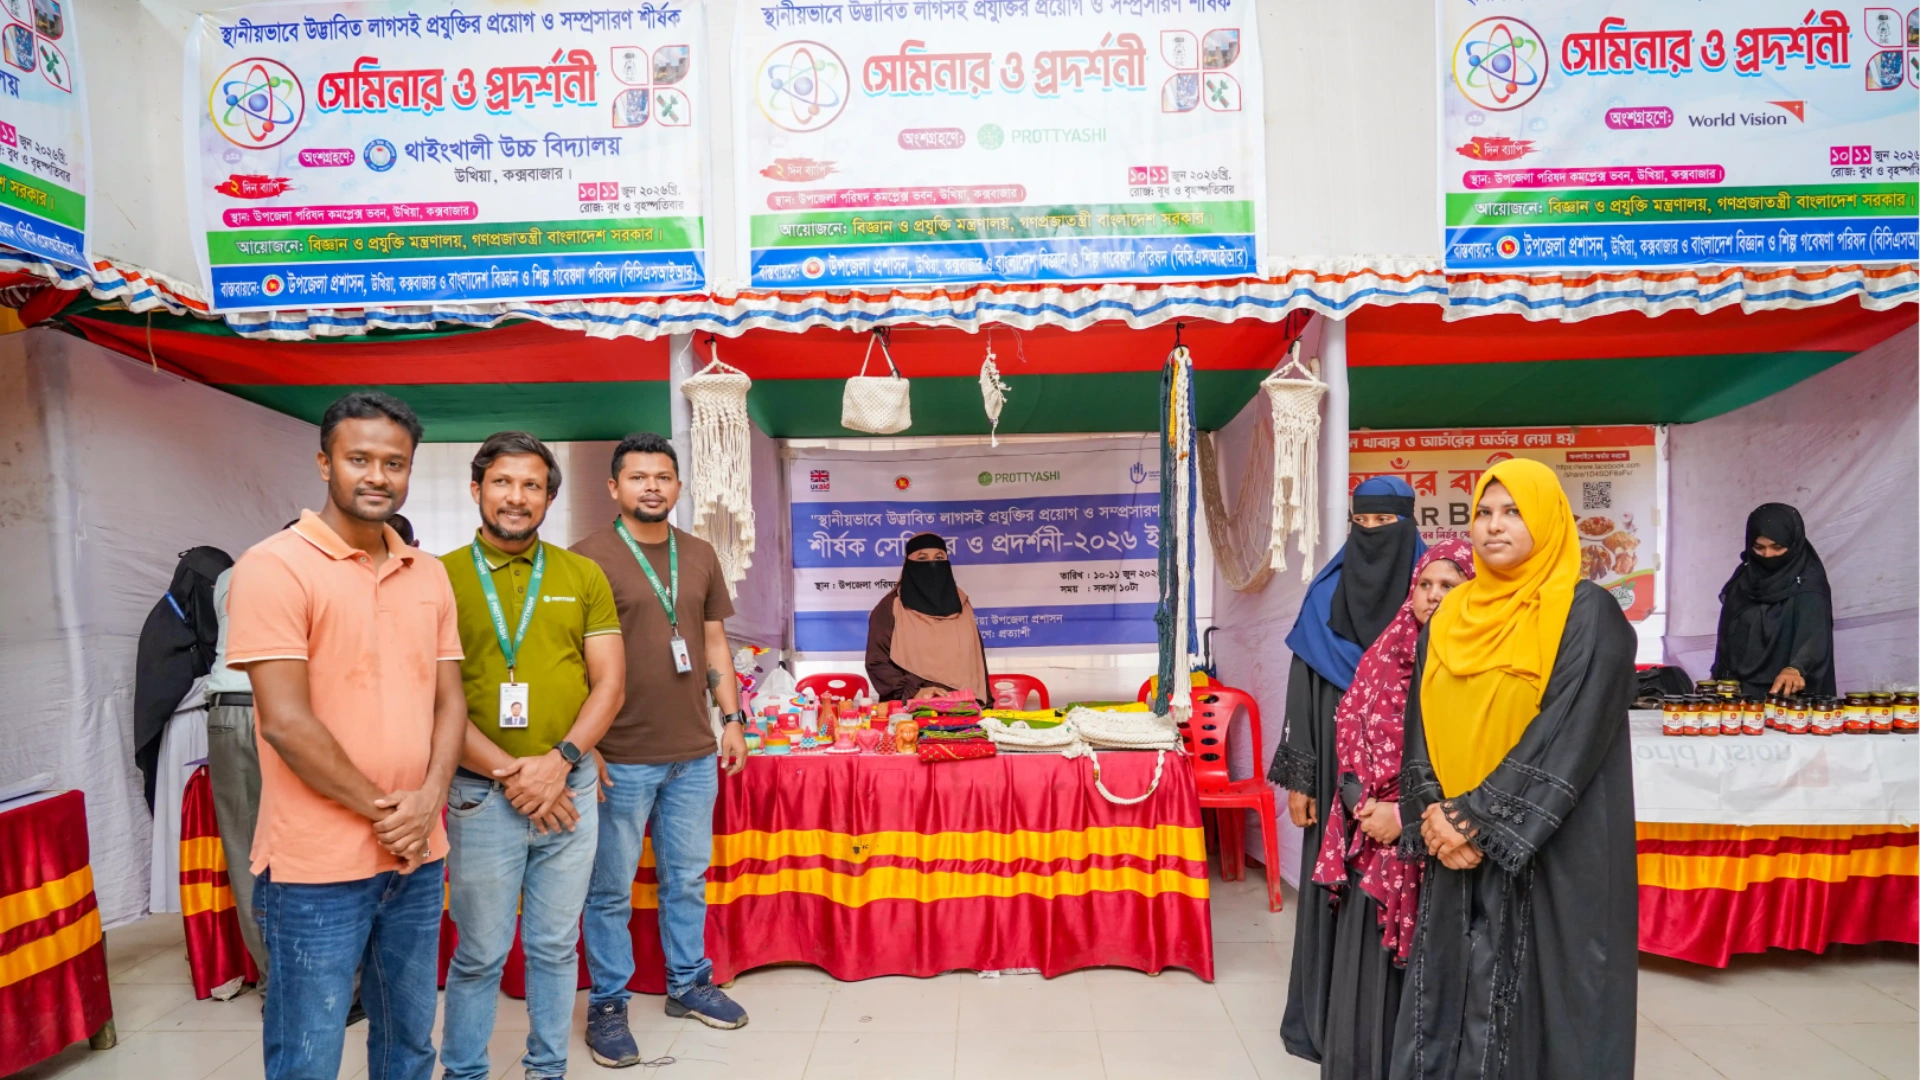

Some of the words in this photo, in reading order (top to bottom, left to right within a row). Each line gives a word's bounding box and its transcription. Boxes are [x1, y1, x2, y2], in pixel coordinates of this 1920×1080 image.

[219, 17, 300, 49] স্থানীয়ভাবে
[303, 13, 363, 42] উদ্ভাবিত
[367, 11, 422, 39] লাগসই
[426, 8, 481, 40] প্রযুক্তির
[487, 10, 536, 35] প্রয়োগ
[541, 12, 554, 30] ও
[560, 6, 633, 34] সম্প্রসারণ
[637, 1, 682, 30] শীর্ষক
[1560, 16, 1693, 78] সেমিনার
[1699, 29, 1728, 72] ও
[1734, 8, 1852, 77] প্রদর্শনী
[862, 38, 994, 98] সেমিনার
[1000, 51, 1026, 94] ও
[1033, 31, 1148, 98] প্রদর্শনী
[316, 56, 446, 116] সেমিনার
[452, 68, 478, 110] ও
[485, 48, 599, 115] প্রদর্শনী
[1688, 112, 1735, 127] World
[1740, 111, 1787, 126] Vision
[1011, 127, 1107, 145] PROTTYASHI
[404, 134, 493, 163] থাইংখালী
[499, 132, 538, 158] উচ্চ
[543, 132, 623, 159] বিদ্যালয়
[1472, 141, 1482, 158] ২
[1484, 143, 1499, 156] দিন
[1501, 142, 1523, 157] ব্যাপি
[1831, 147, 1849, 164] ১০
[1854, 146, 1871, 163] ১১
[1874, 150, 1890, 163] জুন
[776, 163, 785, 178] ২
[787, 163, 801, 177] দিন
[804, 163, 827, 178] ব্যাপি
[1129, 168, 1147, 184] ১০
[1151, 167, 1168, 183] ১১
[1171, 169, 1187, 182] জুন
[230, 180, 241, 195] ২
[242, 181, 257, 194] দিন
[260, 180, 281, 194] ব্যাপি
[579, 184, 597, 200] ১০
[600, 183, 618, 199] ১১
[621, 186, 636, 198] জুন
[1474, 201, 1543, 217] আয়োজনে:
[1547, 196, 1589, 215] বিজ্ঞান
[1593, 200, 1605, 213] ও
[1609, 194, 1649, 217] প্রযুক্তি
[1652, 196, 1713, 214] মন্ত্রণালয়,
[1717, 190, 1791, 211] গণপ্রজাতন্ত্রী
[1796, 192, 1857, 209] বাংলাদেশ
[236, 239, 304, 256] আয়োজনে:
[307, 234, 348, 253] বিজ্ঞান
[352, 237, 364, 251] ও
[368, 232, 405, 254] প্রযুক্তি
[408, 234, 467, 251] মন্ত্রণালয়,
[471, 226, 543, 248] গণপ্রজাতন্ত্রী
[547, 228, 607, 245] বাংলাদেশ
[220, 280, 260, 298] বাস্তবায়নে:
[287, 270, 328, 295] উপজেলা
[330, 272, 367, 297] প্রশাসন,
[371, 271, 396, 295] উখিয়া,
[399, 274, 437, 293] কক্সবাজার
[439, 276, 446, 290] ও
[449, 269, 488, 292] বাংলাদেশ
[491, 264, 518, 288] বিজ্ঞান
[522, 270, 529, 286] ও
[532, 263, 550, 288] শিল্প
[553, 266, 585, 287] গবেষণা
[588, 261, 617, 285] পরিষদ
[619, 257, 697, 287] (বিসিএসআইআর)
[1363, 437, 1401, 450] খাবার
[1405, 437, 1416, 448] ও
[1480, 431, 1519, 447] অর্ডার
[1523, 433, 1552, 447] নেয়া
[1556, 433, 1575, 446] হয়
[995, 470, 1061, 483] PROTTYASHI
[885, 508, 936, 527] উদ্ভাবিত
[940, 507, 985, 526] লাগসই
[988, 506, 1034, 526] প্রযুক্তির
[1038, 506, 1078, 521] প্রয়োগ
[1083, 507, 1094, 519] ও
[1098, 503, 1160, 520] সম্প্রসারণ
[808, 530, 867, 559] শীর্ষক
[967, 536, 983, 554] ও
[992, 525, 1137, 556] প্রদর্শনী-২০২৬
[1138, 569, 1159, 579] ২০২
[991, 613, 1029, 626] উপজেলা
[1031, 613, 1063, 625] প্রশাসন
